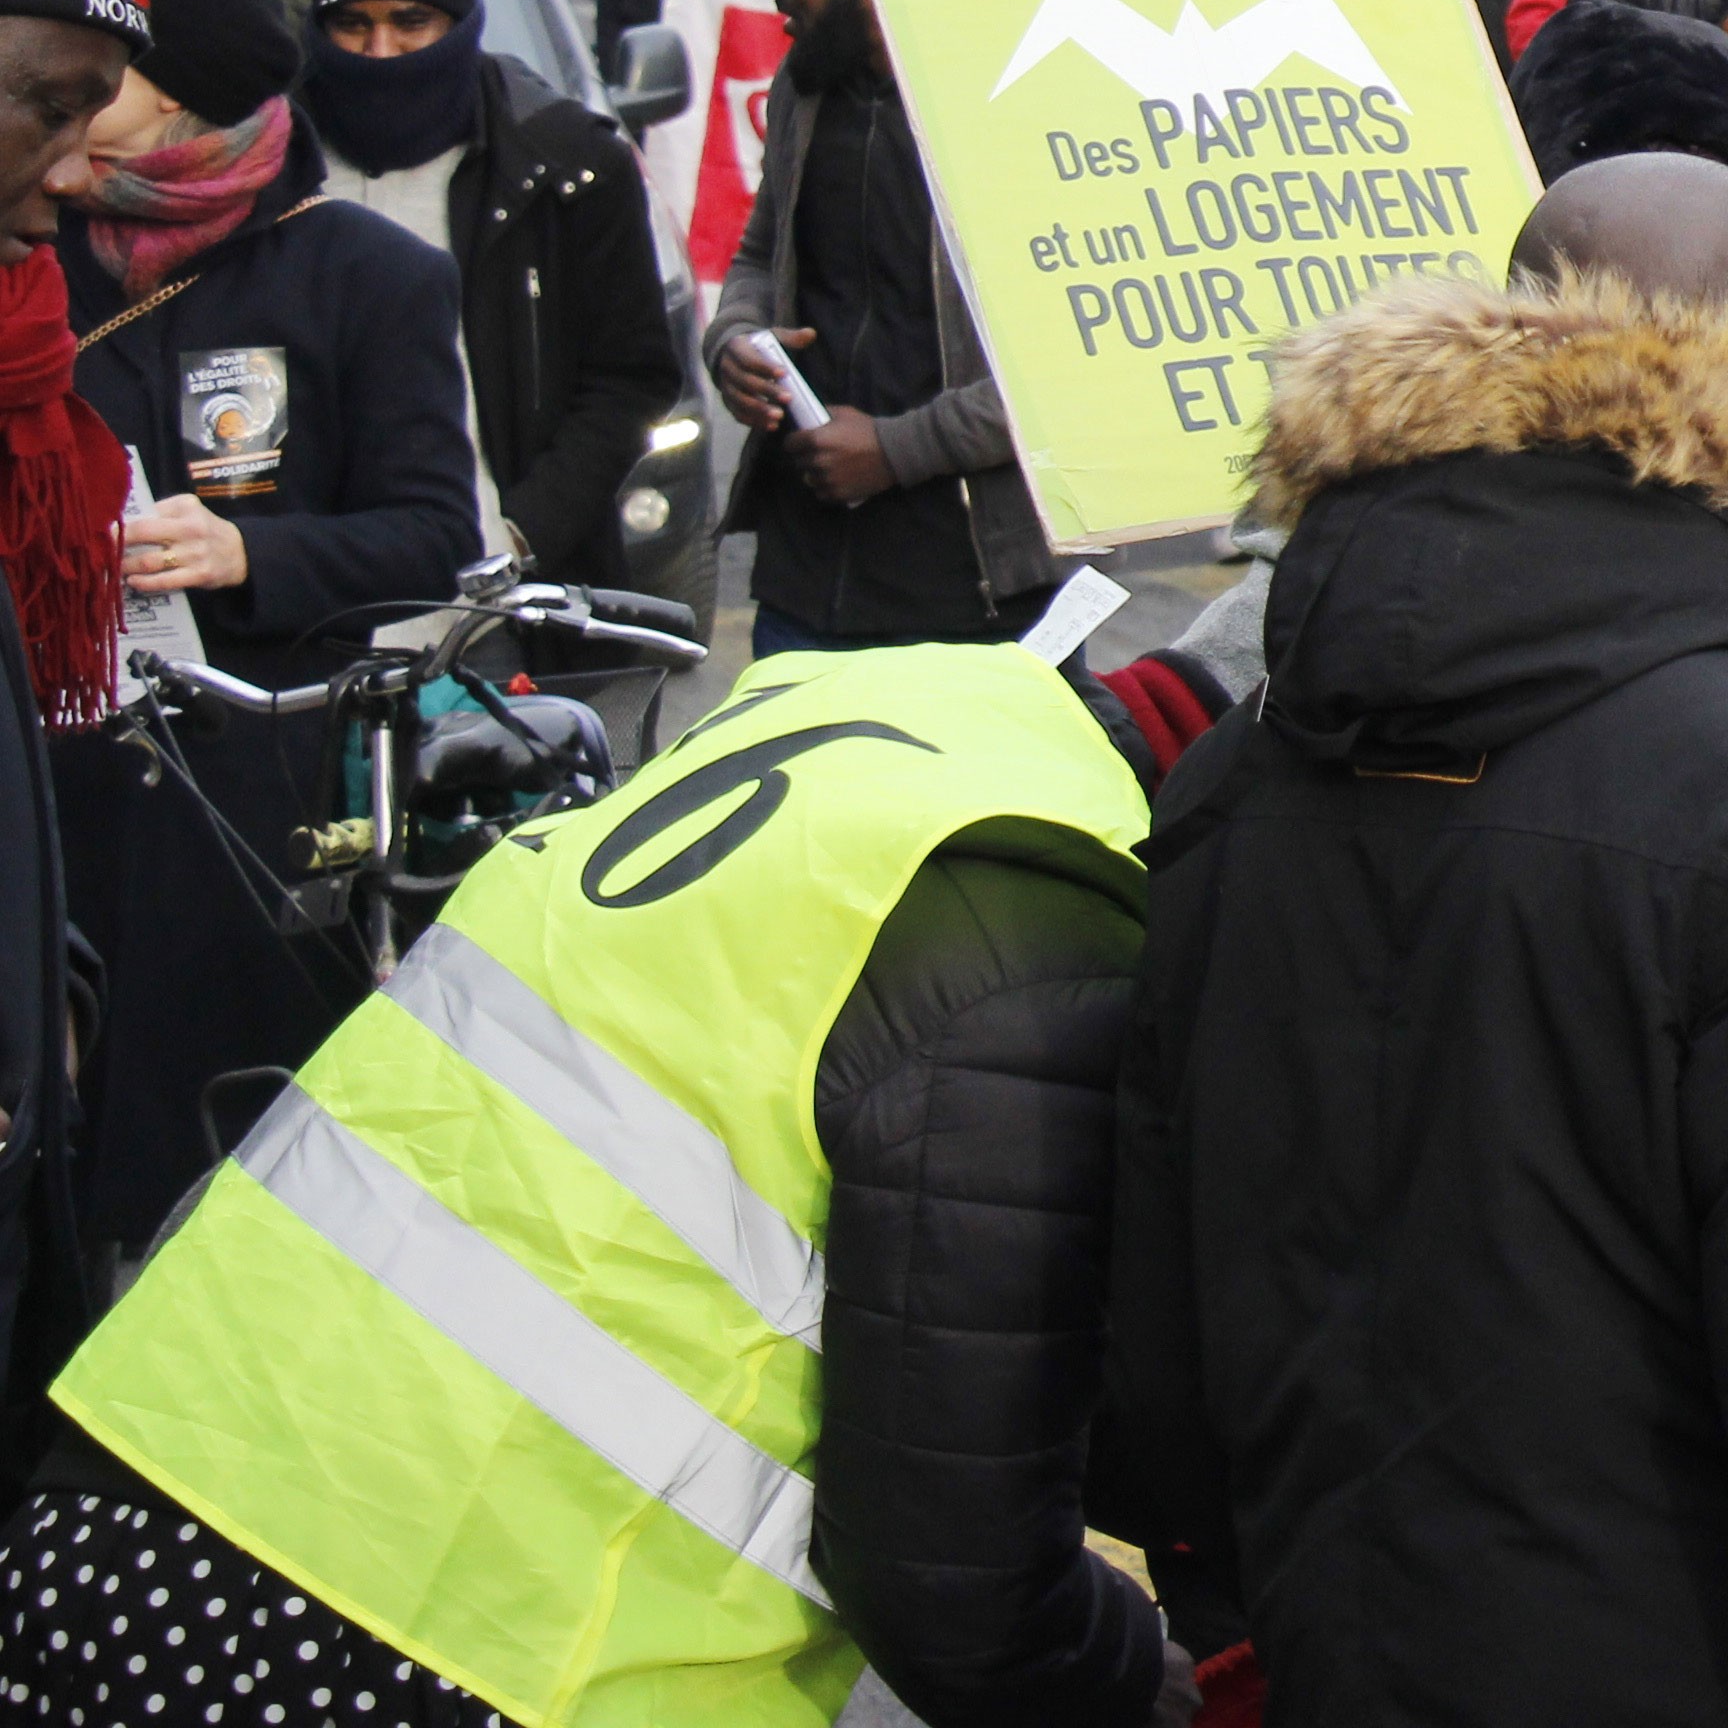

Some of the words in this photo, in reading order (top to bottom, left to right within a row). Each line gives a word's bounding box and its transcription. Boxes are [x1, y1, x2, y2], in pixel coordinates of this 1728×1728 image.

[1046, 130, 1141, 181] Des
[1138, 85, 1411, 170] PAPIERS
[1029, 222, 1079, 273] et
[1083, 222, 1147, 266] un
[1144, 166, 1480, 257] LOGEMENT
[1066, 266, 1260, 357] POUR
[190, 380, 216, 394] DES
[213, 354, 248, 368] POUR
[1162, 354, 1242, 432] ET
